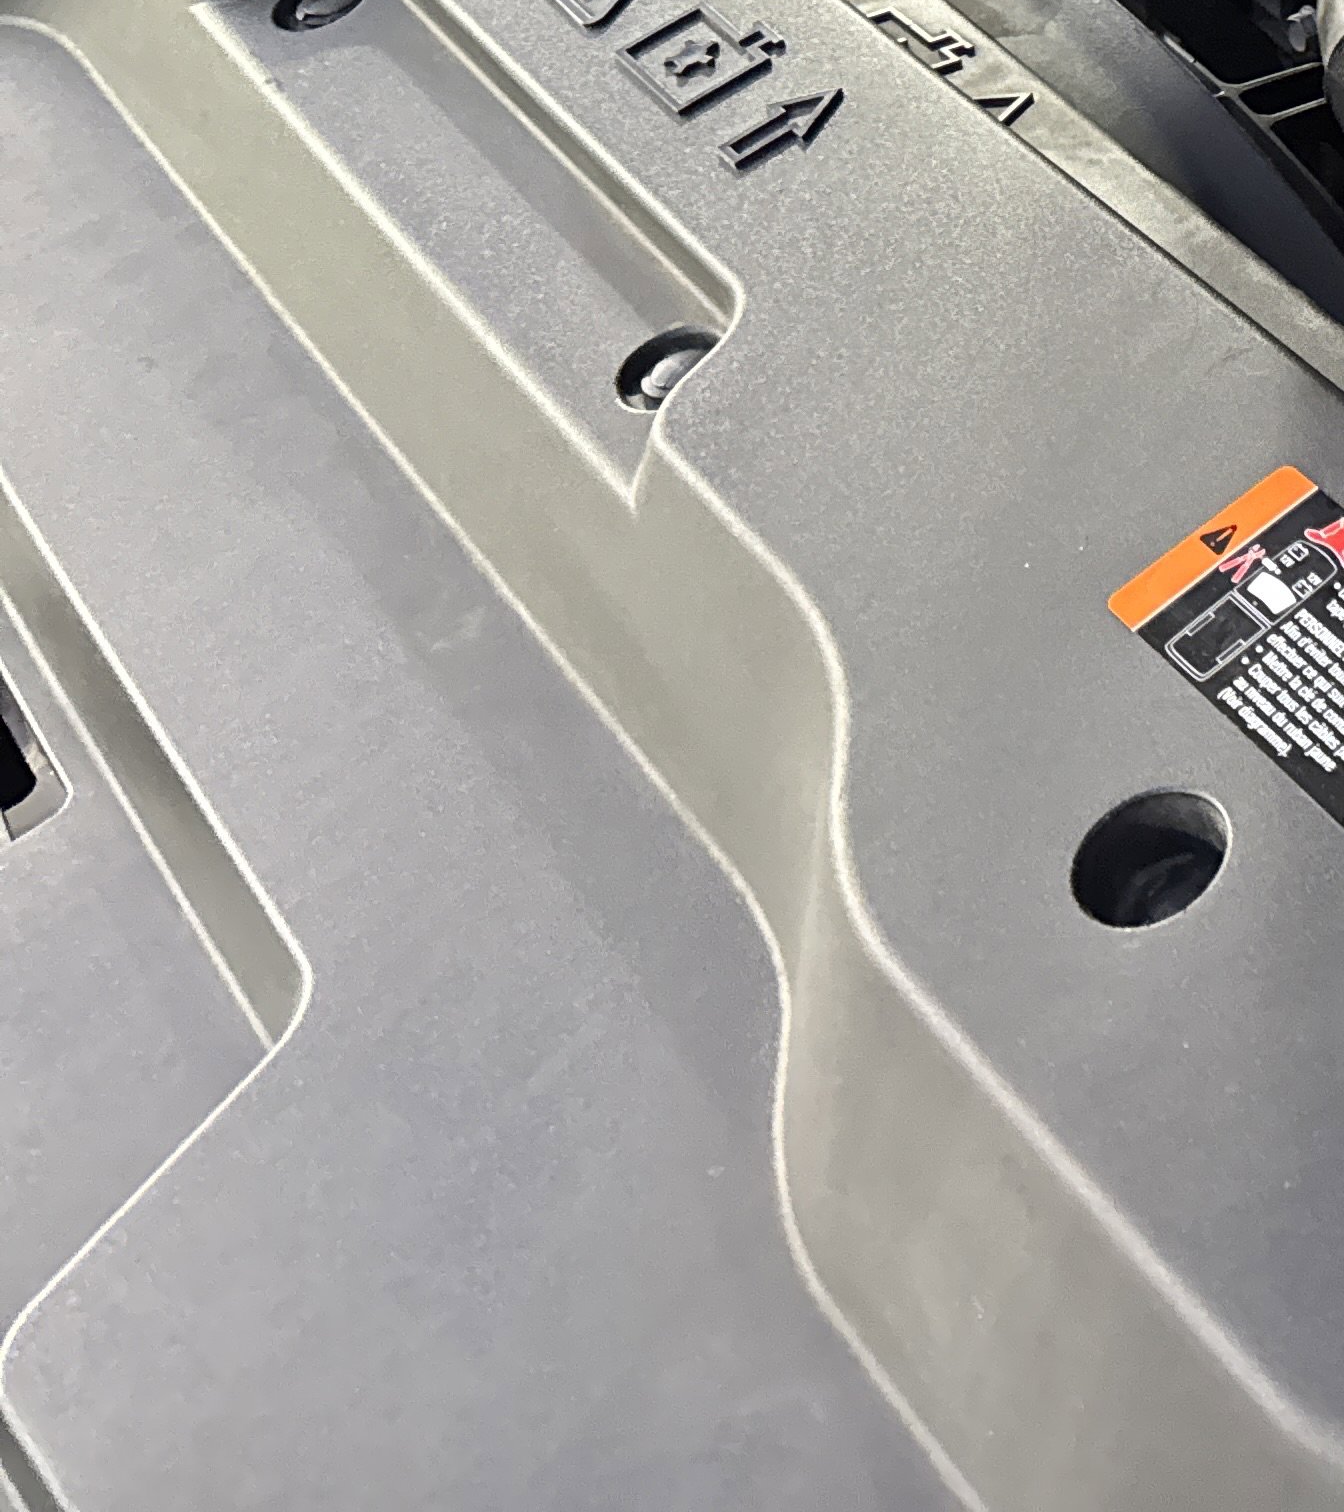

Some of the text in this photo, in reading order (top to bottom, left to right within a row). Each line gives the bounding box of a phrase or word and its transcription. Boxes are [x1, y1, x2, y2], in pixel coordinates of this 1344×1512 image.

[1279, 619, 1304, 641] Afin
[1244, 662, 1284, 697] Couper
[1274, 688, 1302, 712] tous
[1293, 705, 1316, 724] les
[1260, 650, 1296, 682] Mettre
[1287, 675, 1304, 690] la
[1296, 683, 1318, 702] clé
[1309, 696, 1330, 713] de
[1265, 631, 1310, 670] effectuer
[1301, 665, 1318, 680] ce
[1310, 673, 1334, 694] qui
[1214, 685, 1245, 712] (Voir
[1231, 675, 1340, 774] au niveau du ruban jaune
